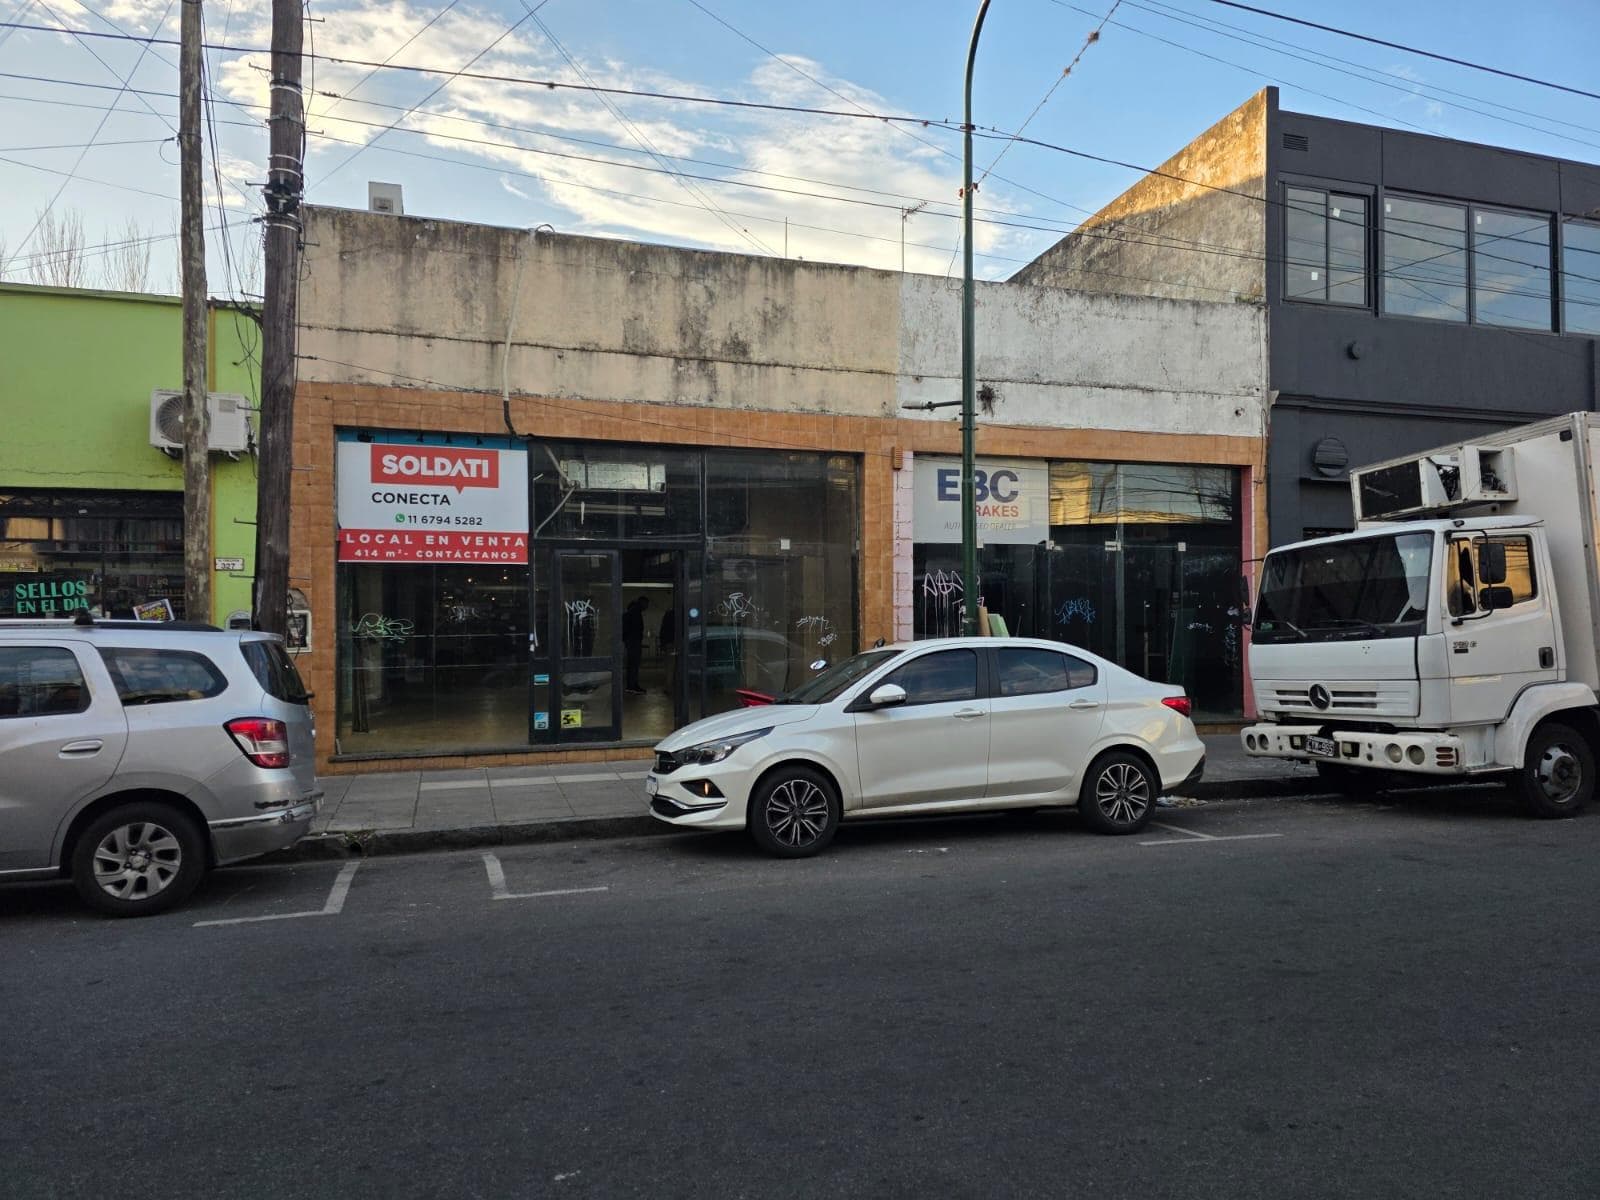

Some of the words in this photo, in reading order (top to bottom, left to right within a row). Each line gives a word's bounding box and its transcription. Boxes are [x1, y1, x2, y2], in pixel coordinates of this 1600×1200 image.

[382, 454, 489, 478] SOLDATI
[937, 468, 1019, 503] EBC
[372, 492, 451, 506] CONECTA
[975, 504, 1019, 518] RAKES
[408, 515, 417, 524] 11
[421, 515, 451, 525] 6794
[455, 516, 483, 526] 5282
[345, 533, 413, 545] LOCAL
[426, 535, 449, 545] EN
[461, 536, 526, 547] VENTA
[354, 549, 378, 557] 414
[416, 549, 518, 559] CONTÁCTANOS
[15, 581, 87, 599] SELLOS
[17, 601, 36, 614] EN
[41, 599, 60, 613] EL
[63, 597, 89, 612] DIA
